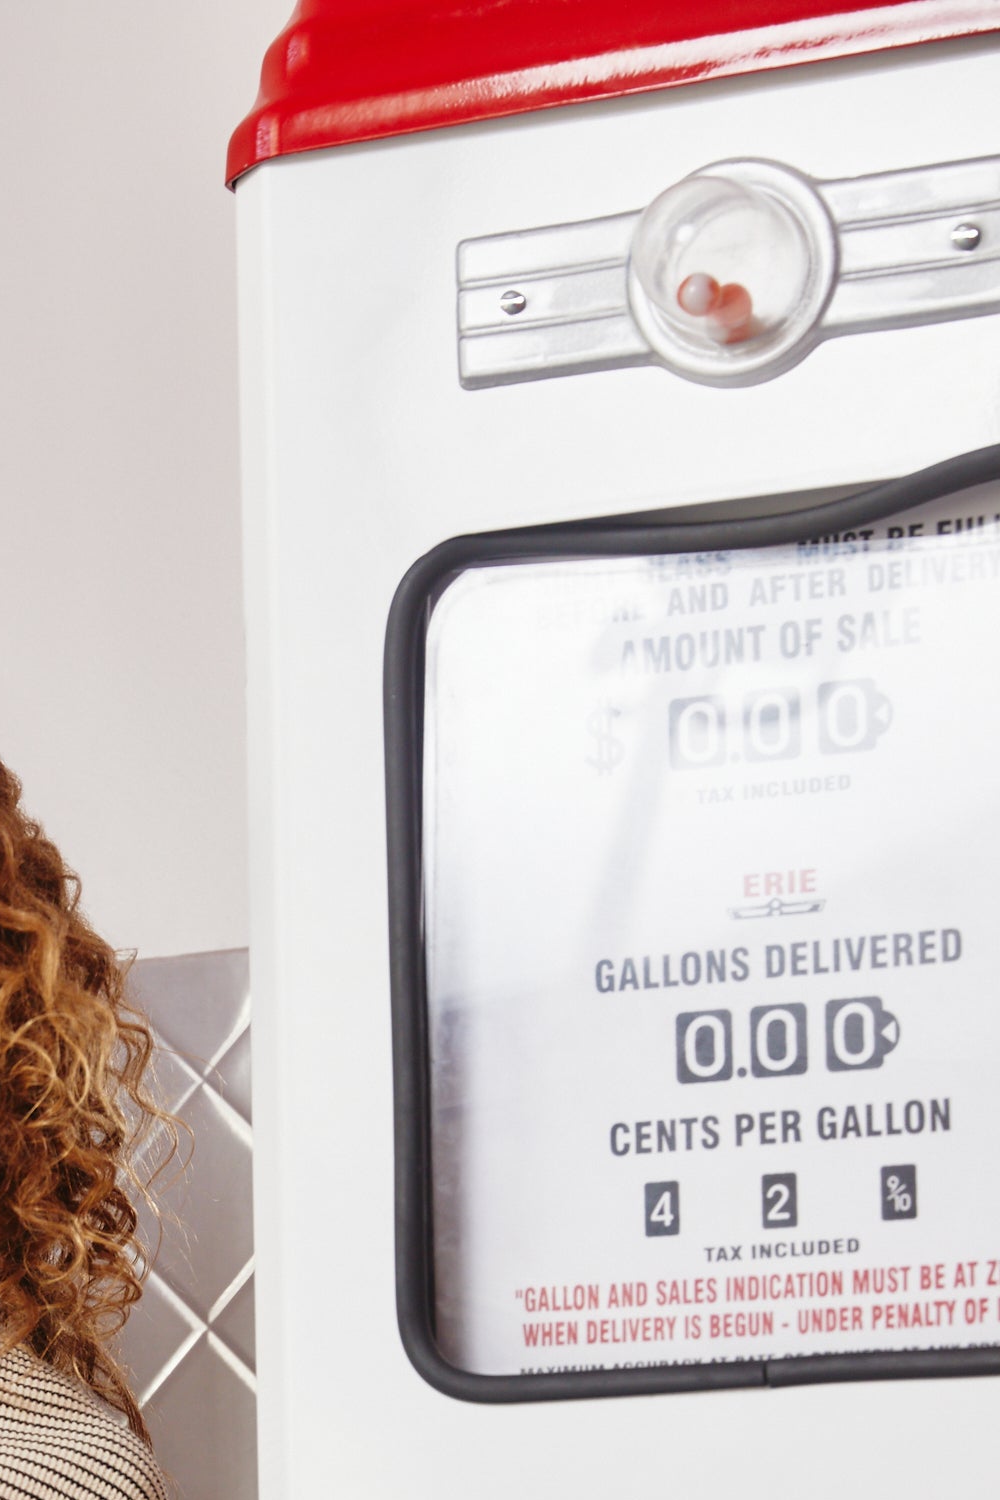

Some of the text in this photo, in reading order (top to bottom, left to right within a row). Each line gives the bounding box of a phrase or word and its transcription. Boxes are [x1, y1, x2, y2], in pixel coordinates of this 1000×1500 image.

[666, 582, 729, 617] AND
[749, 568, 847, 607] AFTER
[621, 606, 921, 677] AMOUNT OF SALE
[696, 774, 852, 806] TAX INCLUDED
[743, 868, 817, 898] ERIE
[595, 928, 963, 994] GALLONS DELIVERED
[610, 1098, 952, 1157] CENTS PER GALLON
[650, 1191, 675, 1228] 4
[766, 1184, 791, 1221] 2
[704, 1238, 860, 1263] TAX INCLUDED
[608, 1281, 648, 1308] AND
[656, 1277, 718, 1307] SALES
[726, 1270, 843, 1301] INDICATION
[853, 1266, 911, 1294] MUST
[920, 1263, 945, 1290] BE
[953, 1261, 979, 1289] AT
[523, 1321, 579, 1348] WHEN
[586, 1316, 677, 1345] DELIVERY
[684, 1315, 701, 1340] IS
[709, 1311, 774, 1338] BEGUN
[797, 1306, 864, 1335] UNDER
[872, 1299, 956, 1331] PENALTY
[964, 1298, 989, 1325] OF
